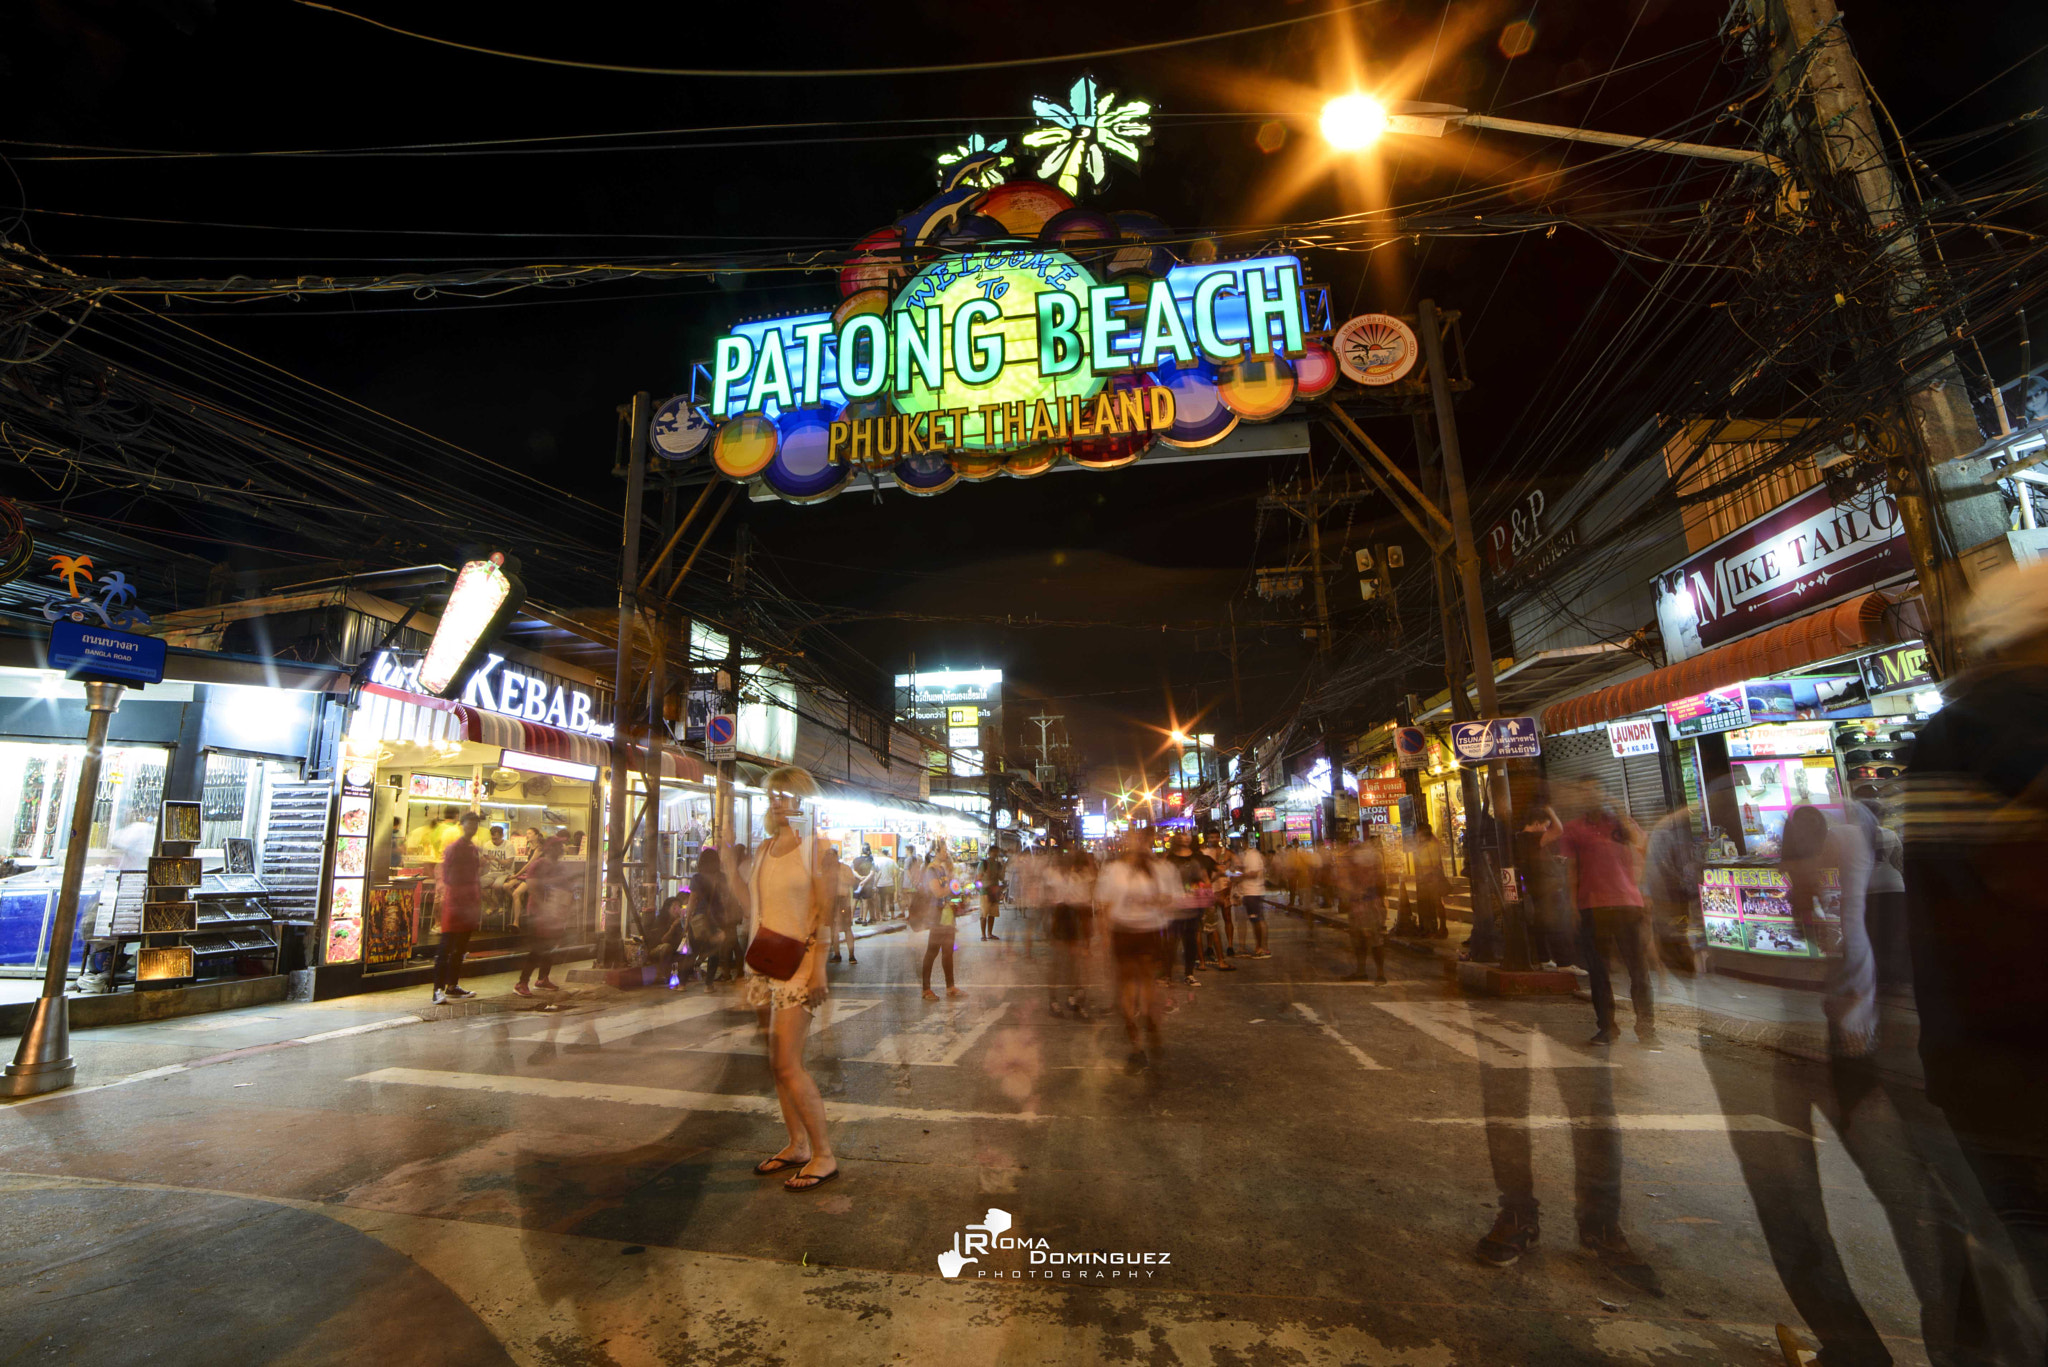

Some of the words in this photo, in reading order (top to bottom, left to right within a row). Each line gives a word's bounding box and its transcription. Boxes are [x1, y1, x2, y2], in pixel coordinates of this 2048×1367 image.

[907, 251, 1078, 309] WELCOME
[976, 276, 1010, 300] TO
[711, 299, 1006, 417] PATONG
[1035, 266, 1304, 378] BEACH
[828, 406, 970, 464] PHUKET
[980, 385, 1177, 447] THAILAND
[1690, 549, 1781, 627] MIKE
[1788, 495, 1899, 568] TAILO
[82, 634, 139, 652] ถนนบางลา
[84, 648, 112, 659] BANGLA
[113, 653, 132, 662] ROAD
[462, 653, 592, 733] KEBAB
[1458, 735, 1492, 745] TSUNAMI
[1610, 722, 1651, 744] LAUNDRY
[1704, 869, 1731, 886] OUR
